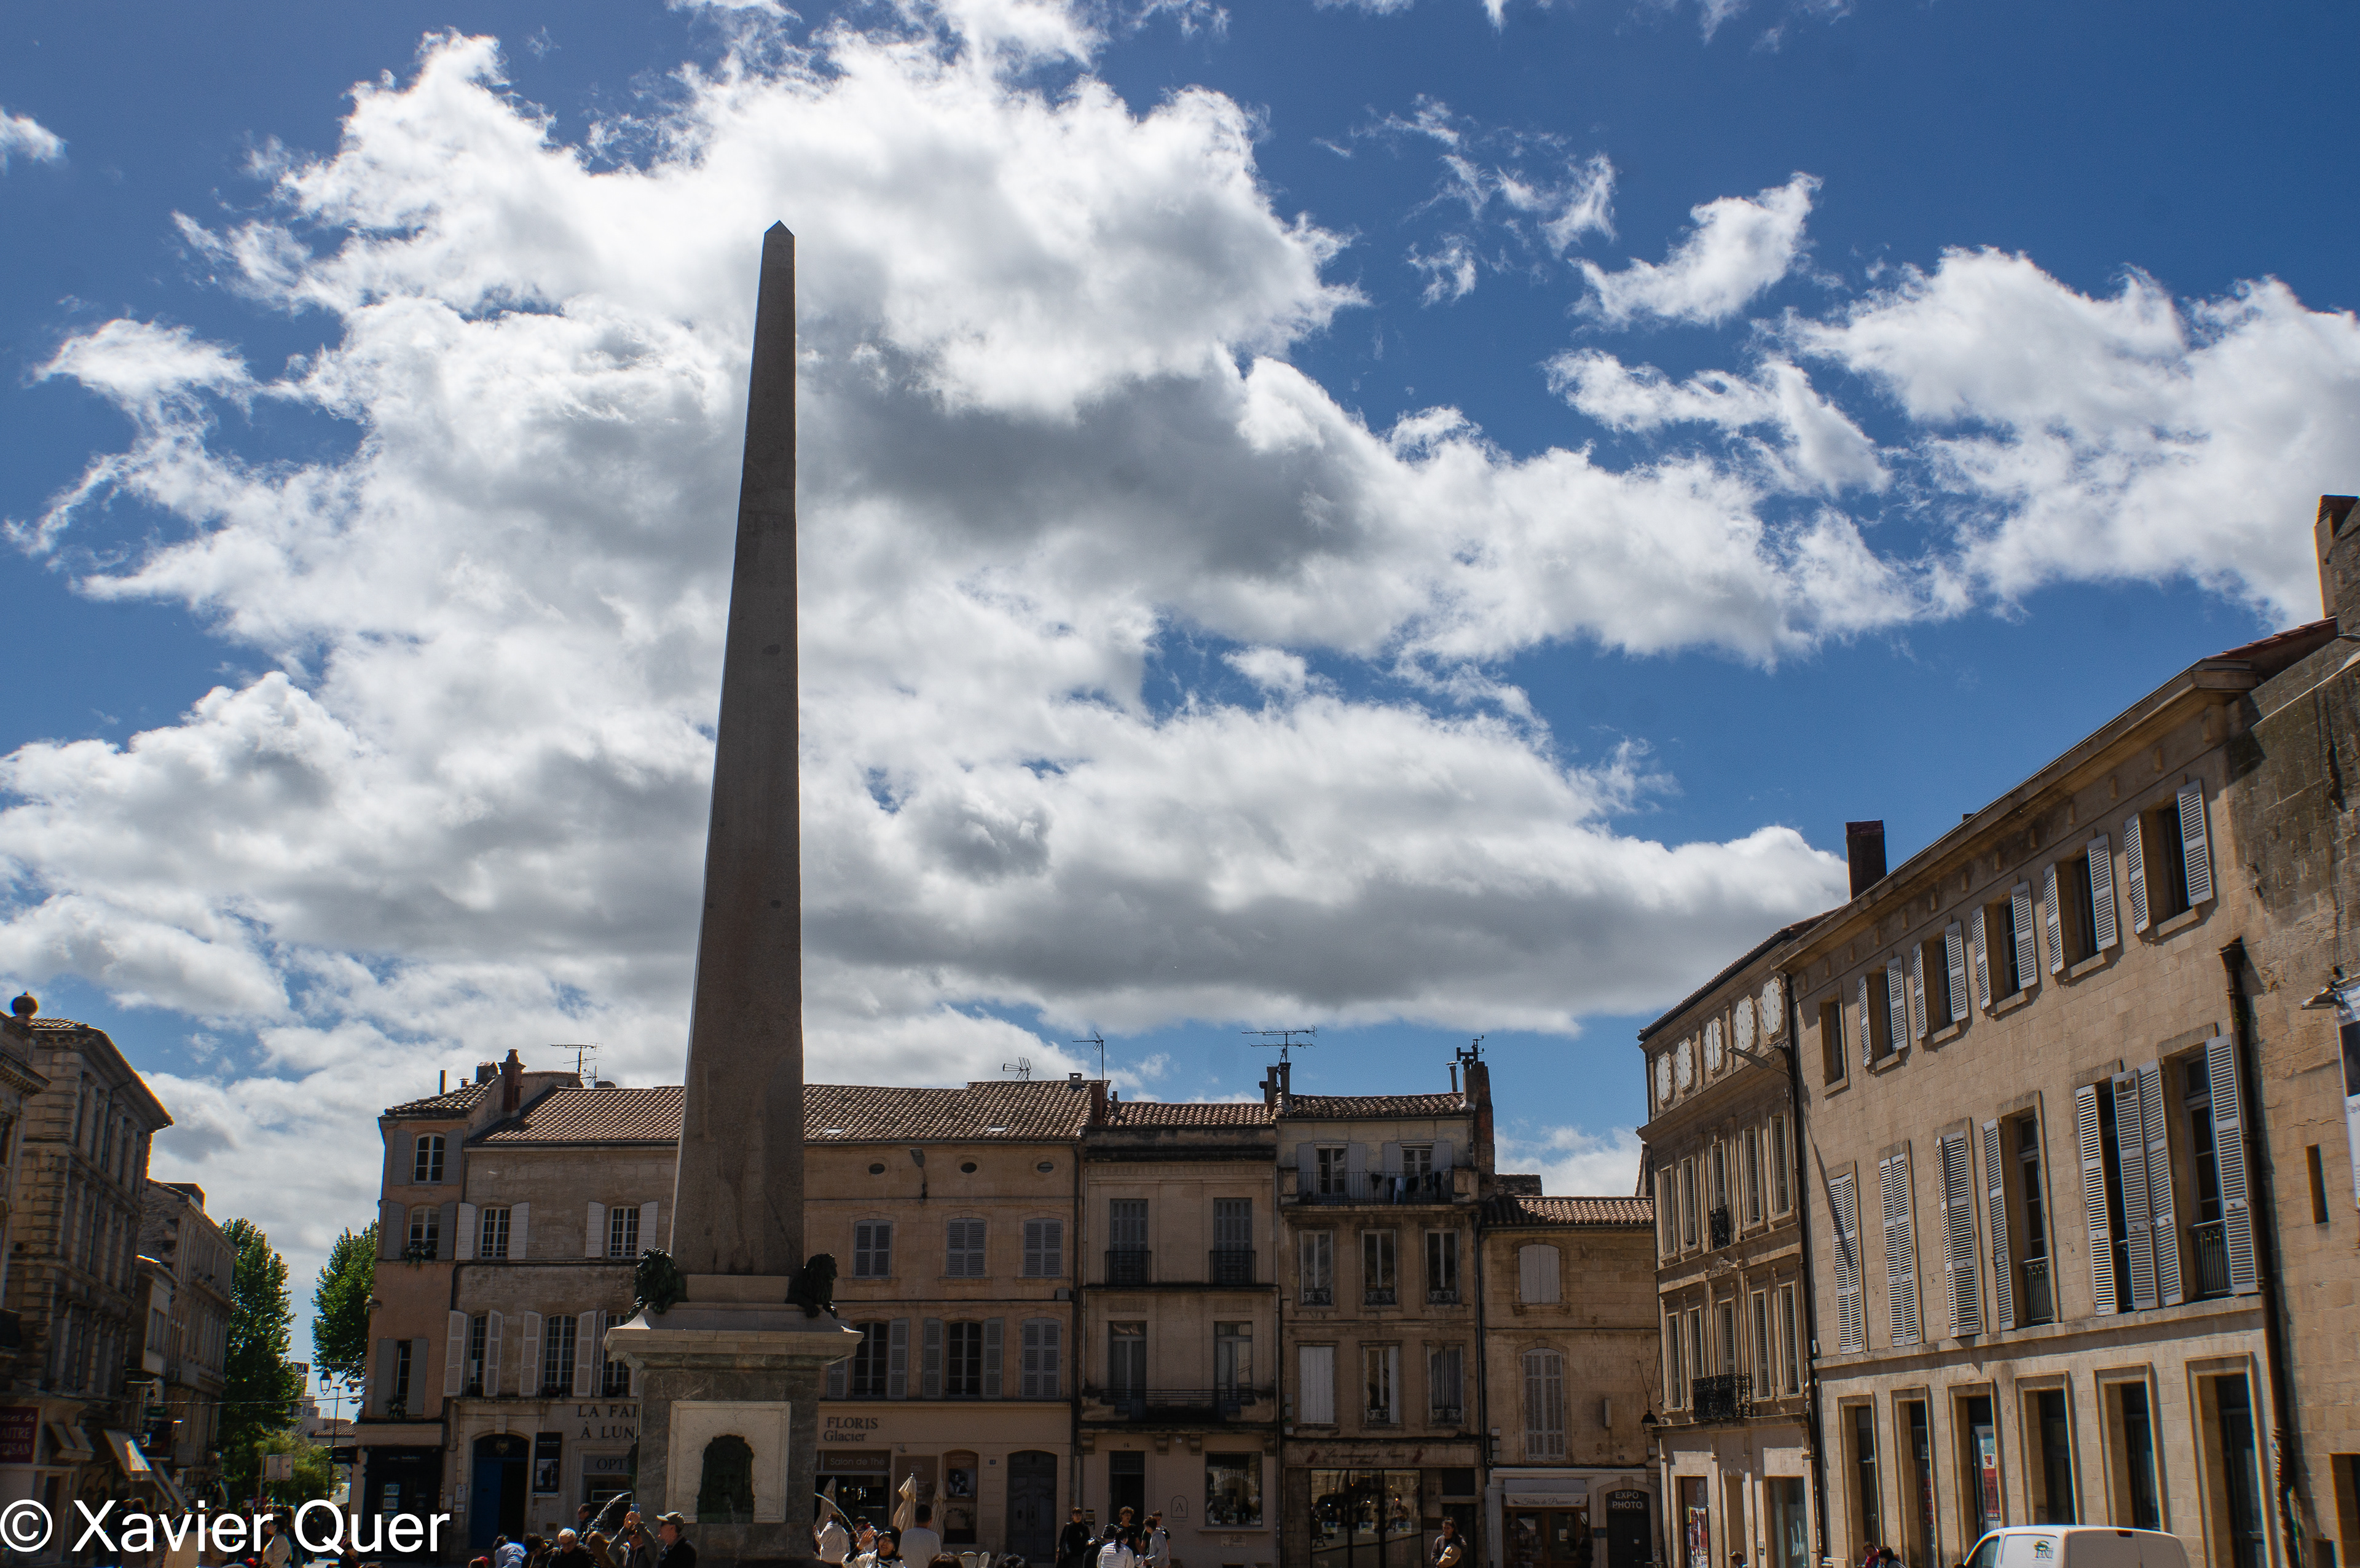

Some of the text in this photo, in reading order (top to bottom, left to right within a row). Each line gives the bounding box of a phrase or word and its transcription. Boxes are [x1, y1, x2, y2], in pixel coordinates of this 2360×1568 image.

[25, 1411, 35, 1422] de
[578, 1405, 599, 1417] LA
[827, 1417, 878, 1429] FLORIS
[0, 1427, 31, 1440] AITRE
[824, 1430, 867, 1442] Glacier
[0, 1443, 31, 1456] TISAN
[597, 1459, 626, 1470] OPT
[830, 1457, 885, 1465] Salon de Thé
